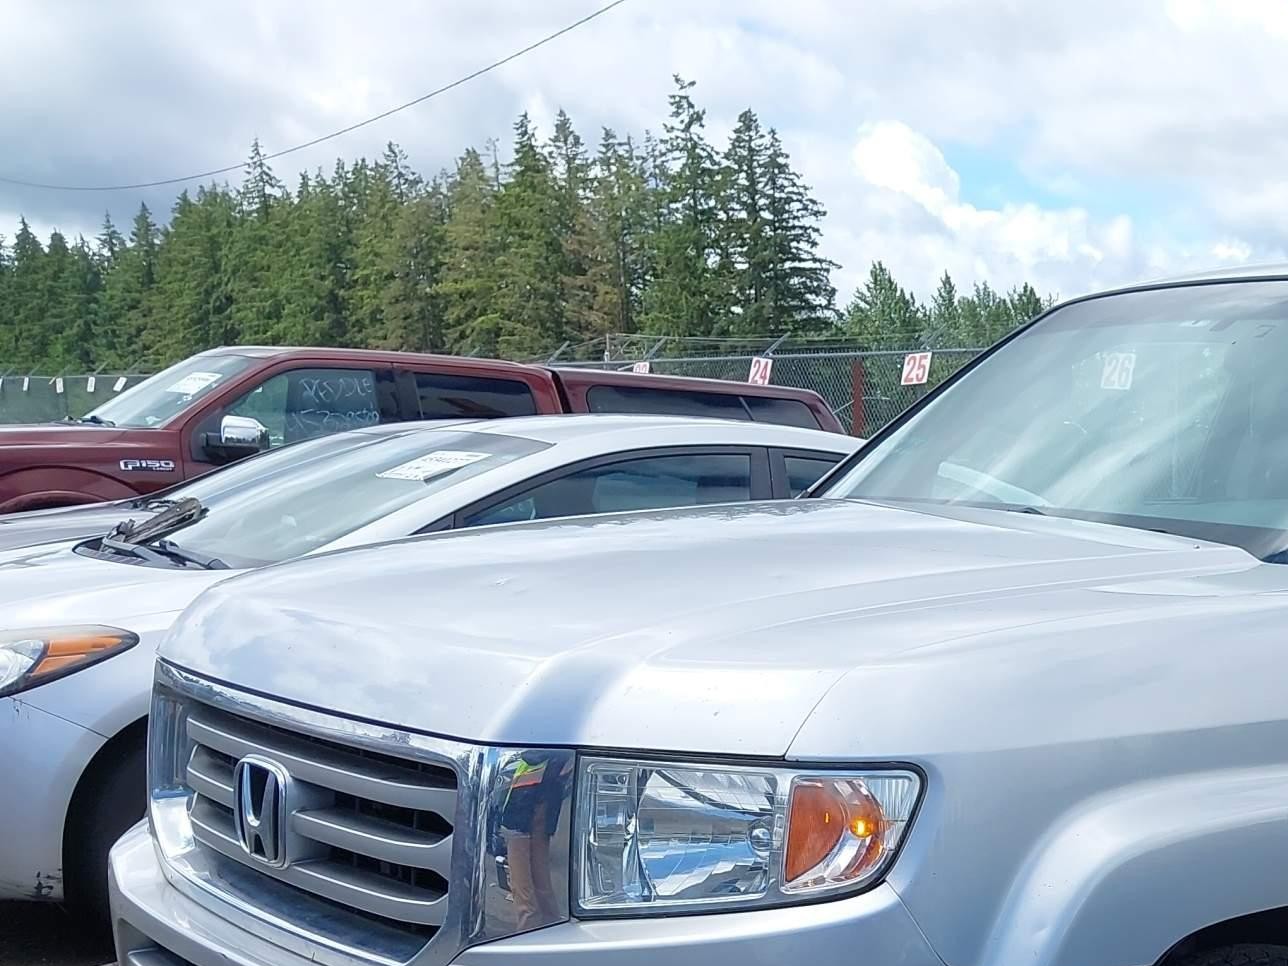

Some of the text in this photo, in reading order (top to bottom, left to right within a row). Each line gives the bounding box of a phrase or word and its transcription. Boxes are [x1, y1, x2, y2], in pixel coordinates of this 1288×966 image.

[750, 359, 769, 385] 24
[903, 354, 928, 383] 25
[1104, 354, 1132, 386] 26
